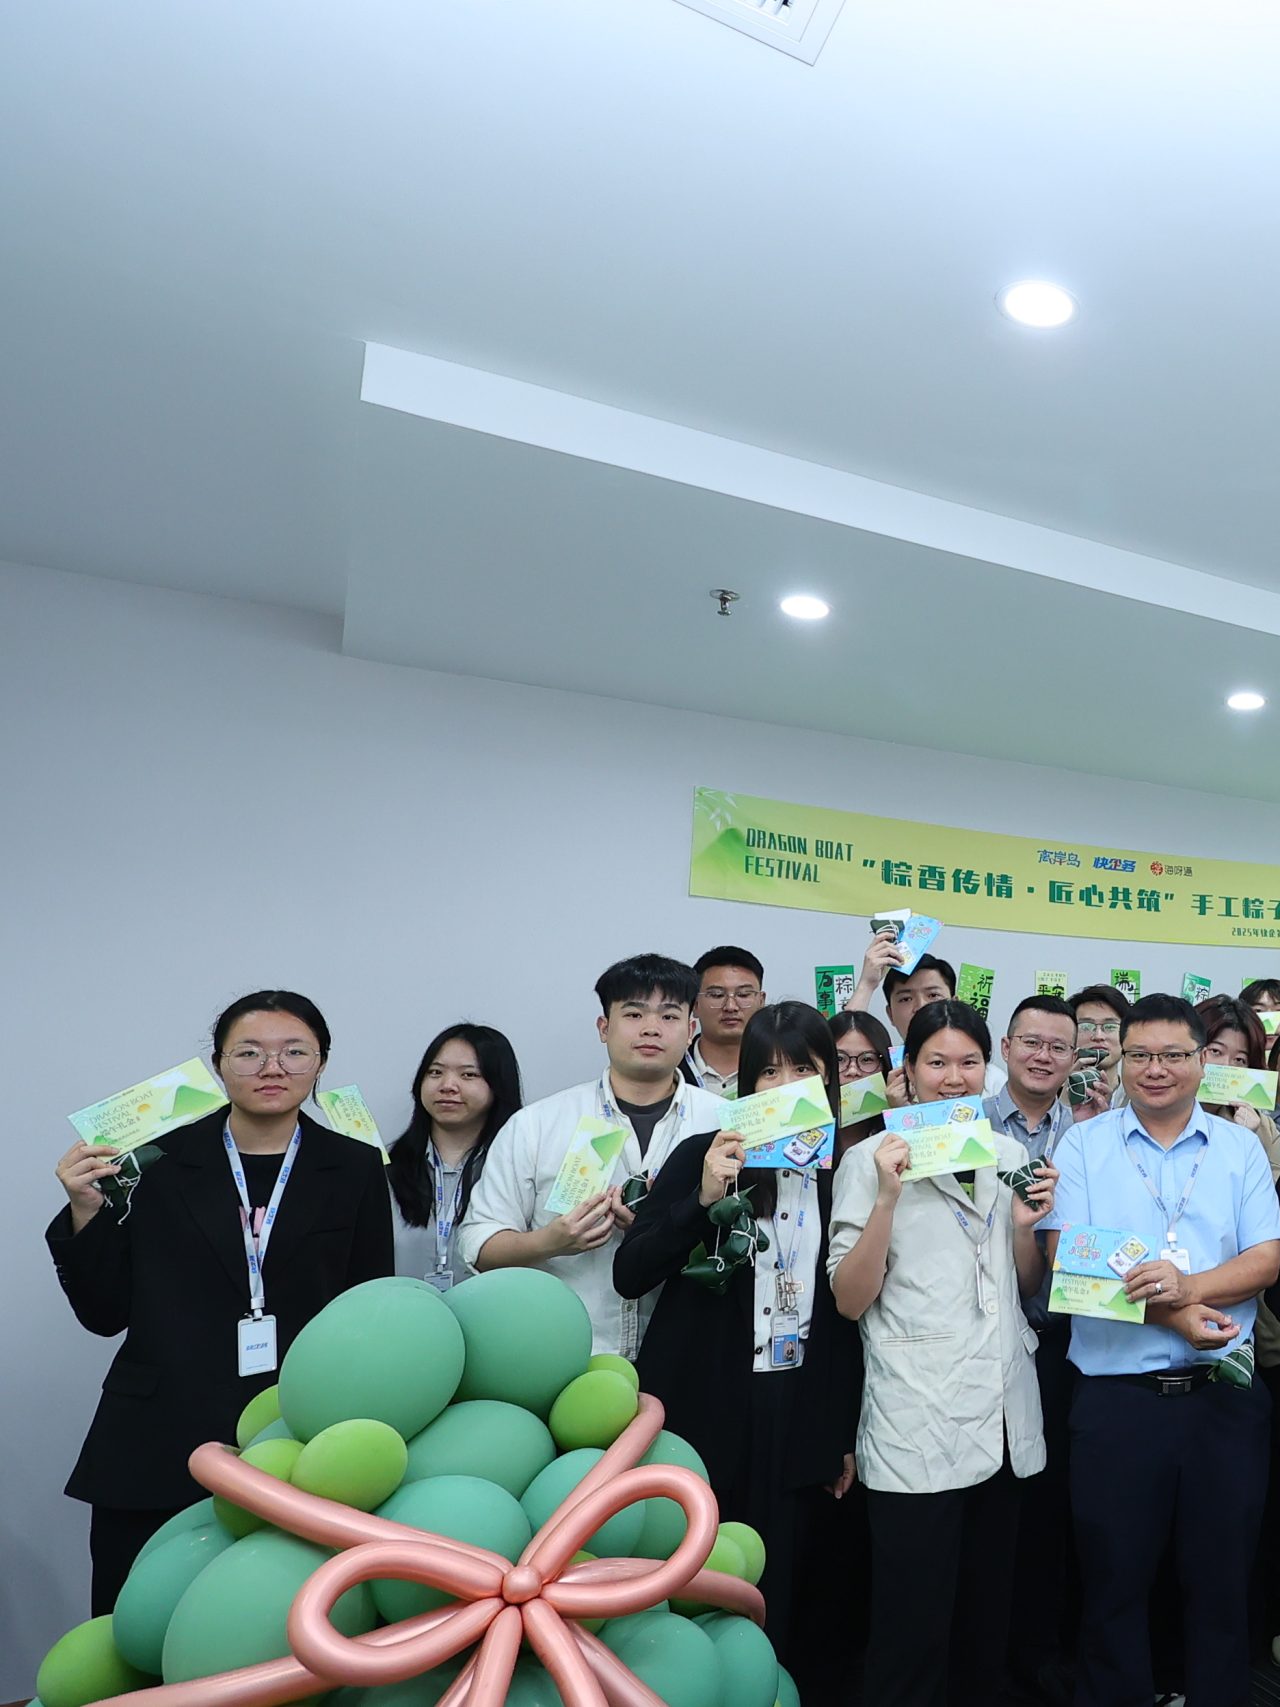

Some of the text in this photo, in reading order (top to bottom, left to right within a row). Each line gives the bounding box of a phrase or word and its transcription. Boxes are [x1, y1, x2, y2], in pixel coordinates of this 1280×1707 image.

[746, 828, 854, 862] DRAGON BOAT
[745, 855, 820, 883] FESTIVAL
[1037, 849, 1081, 868] 离岸岛
[1093, 856, 1136, 873] 快企务
[816, 970, 834, 1010] 万事
